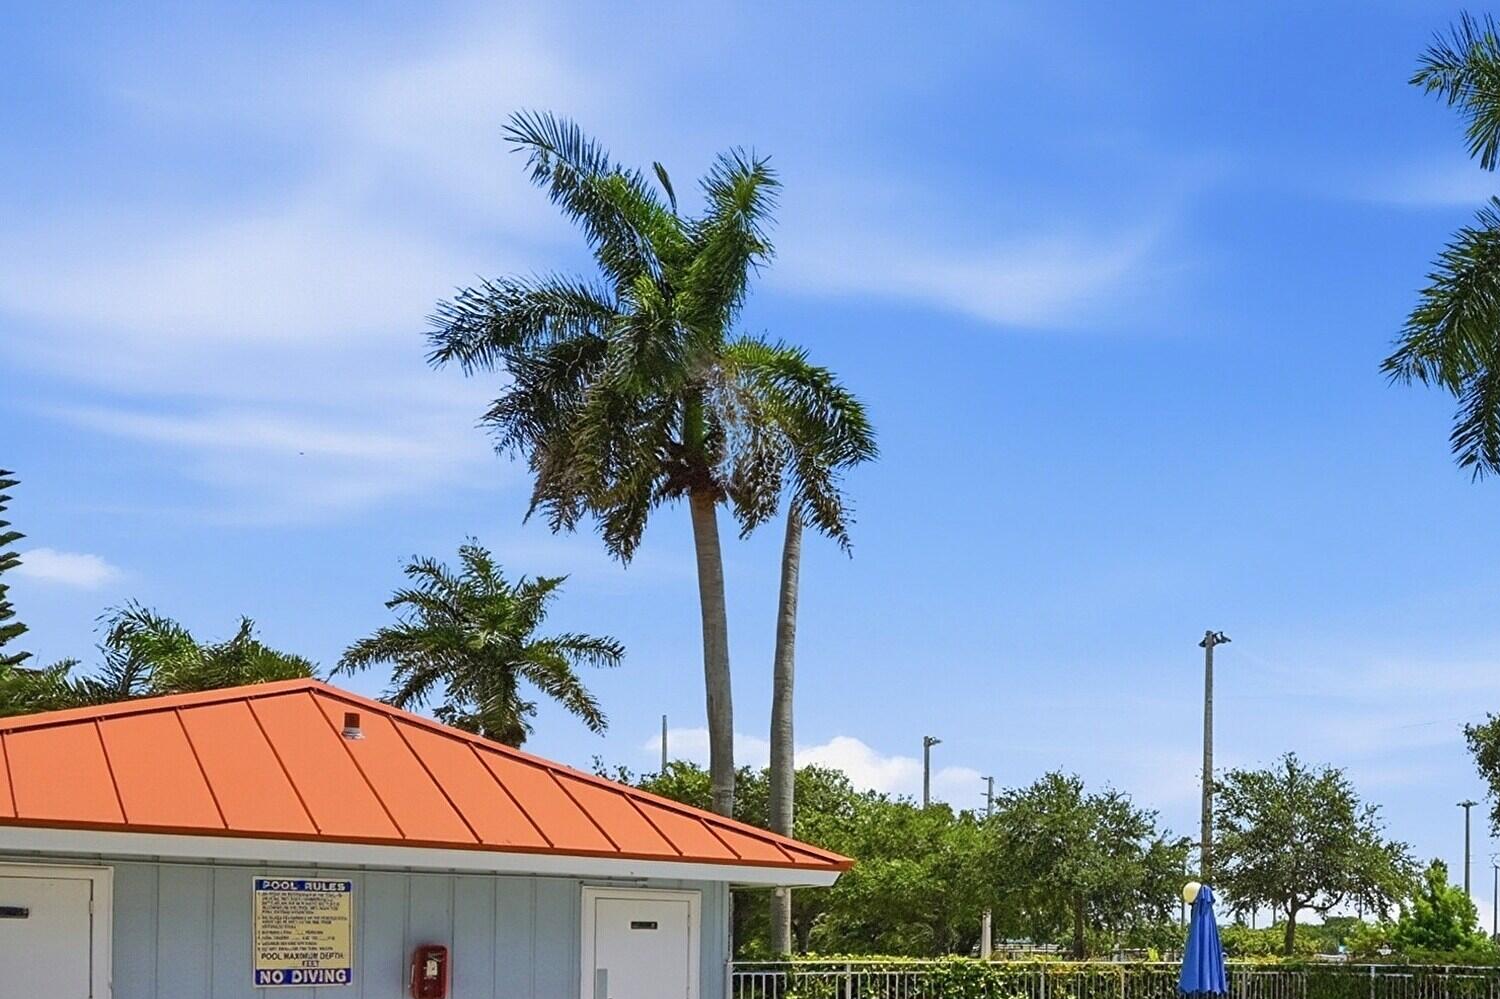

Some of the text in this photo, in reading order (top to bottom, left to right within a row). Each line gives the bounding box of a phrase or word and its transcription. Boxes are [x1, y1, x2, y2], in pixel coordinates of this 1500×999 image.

[262, 880, 345, 891] POOL RULES
[261, 952, 283, 960] POOL
[260, 969, 346, 984] NO DIVING
